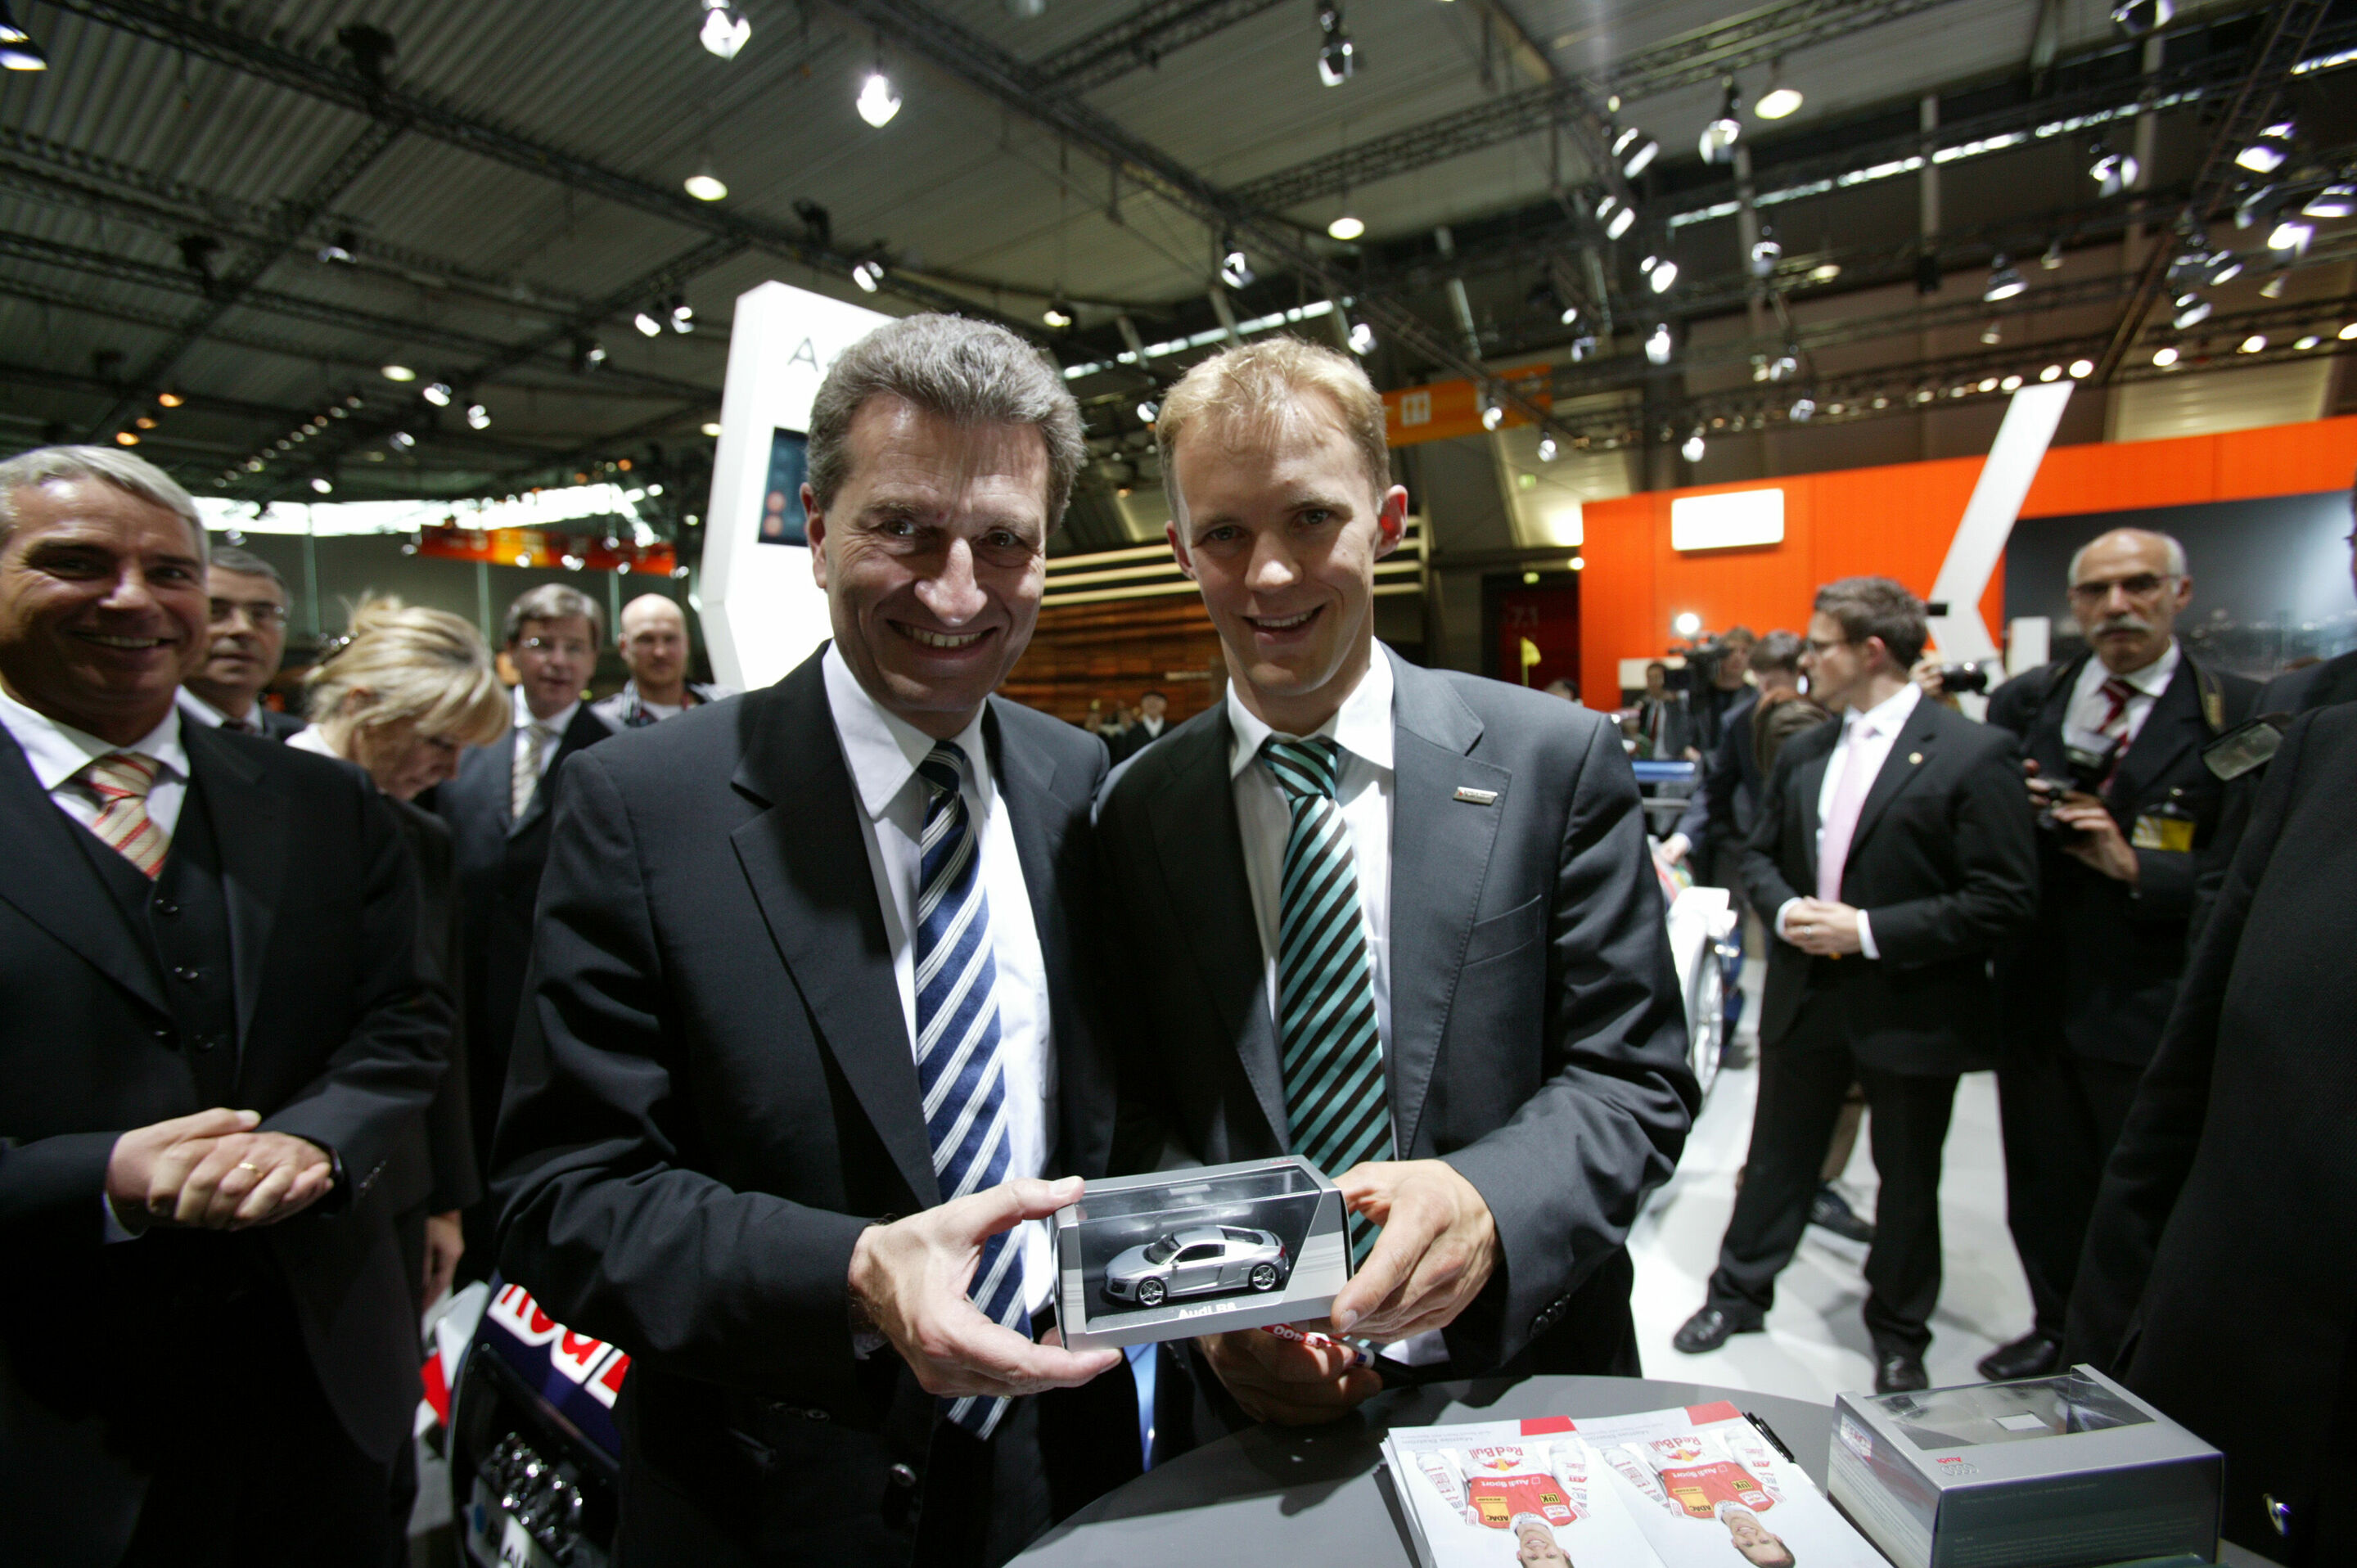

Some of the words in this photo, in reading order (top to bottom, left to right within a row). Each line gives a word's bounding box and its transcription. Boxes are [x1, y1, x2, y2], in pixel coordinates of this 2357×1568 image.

[1178, 1305, 1211, 1318] Audi
[1649, 1439, 1673, 1452] Bull
[1673, 1436, 1702, 1449] Red
[1468, 1448, 1494, 1459] Bull
[1494, 1446, 1523, 1458] Red
[1671, 1470, 1697, 1479] Sport
[1697, 1467, 1717, 1476] Audi
[1480, 1480, 1507, 1489] Sport
[1507, 1478, 1530, 1488] Audi
[1485, 1514, 1509, 1522] ADAC
